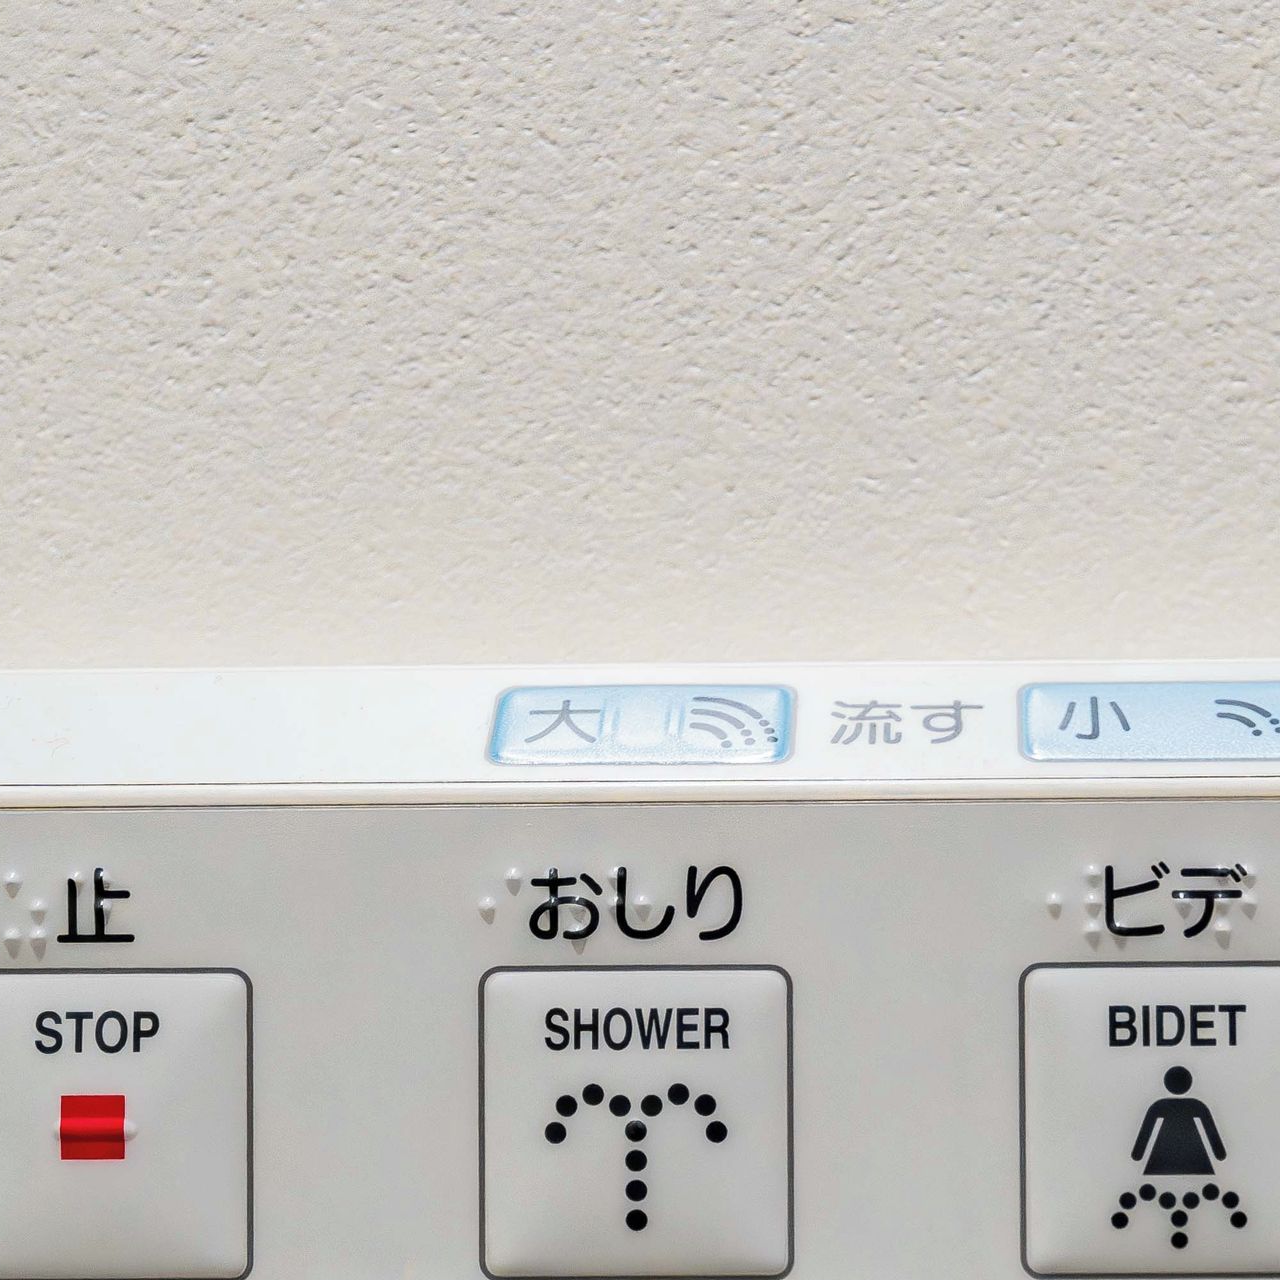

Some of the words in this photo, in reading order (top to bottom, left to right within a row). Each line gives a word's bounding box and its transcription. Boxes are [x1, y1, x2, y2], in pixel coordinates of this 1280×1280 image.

[524, 699, 601, 744] 大
[830, 699, 984, 746] 流す
[1059, 695, 1132, 741] 小
[56, 867, 136, 944] 止
[528, 865, 743, 941] おしり
[1104, 861, 1248, 939] ビデ
[34, 1010, 160, 1055] STOP
[544, 1007, 730, 1052] SHOWER
[1108, 1004, 1247, 1047] BIDET
